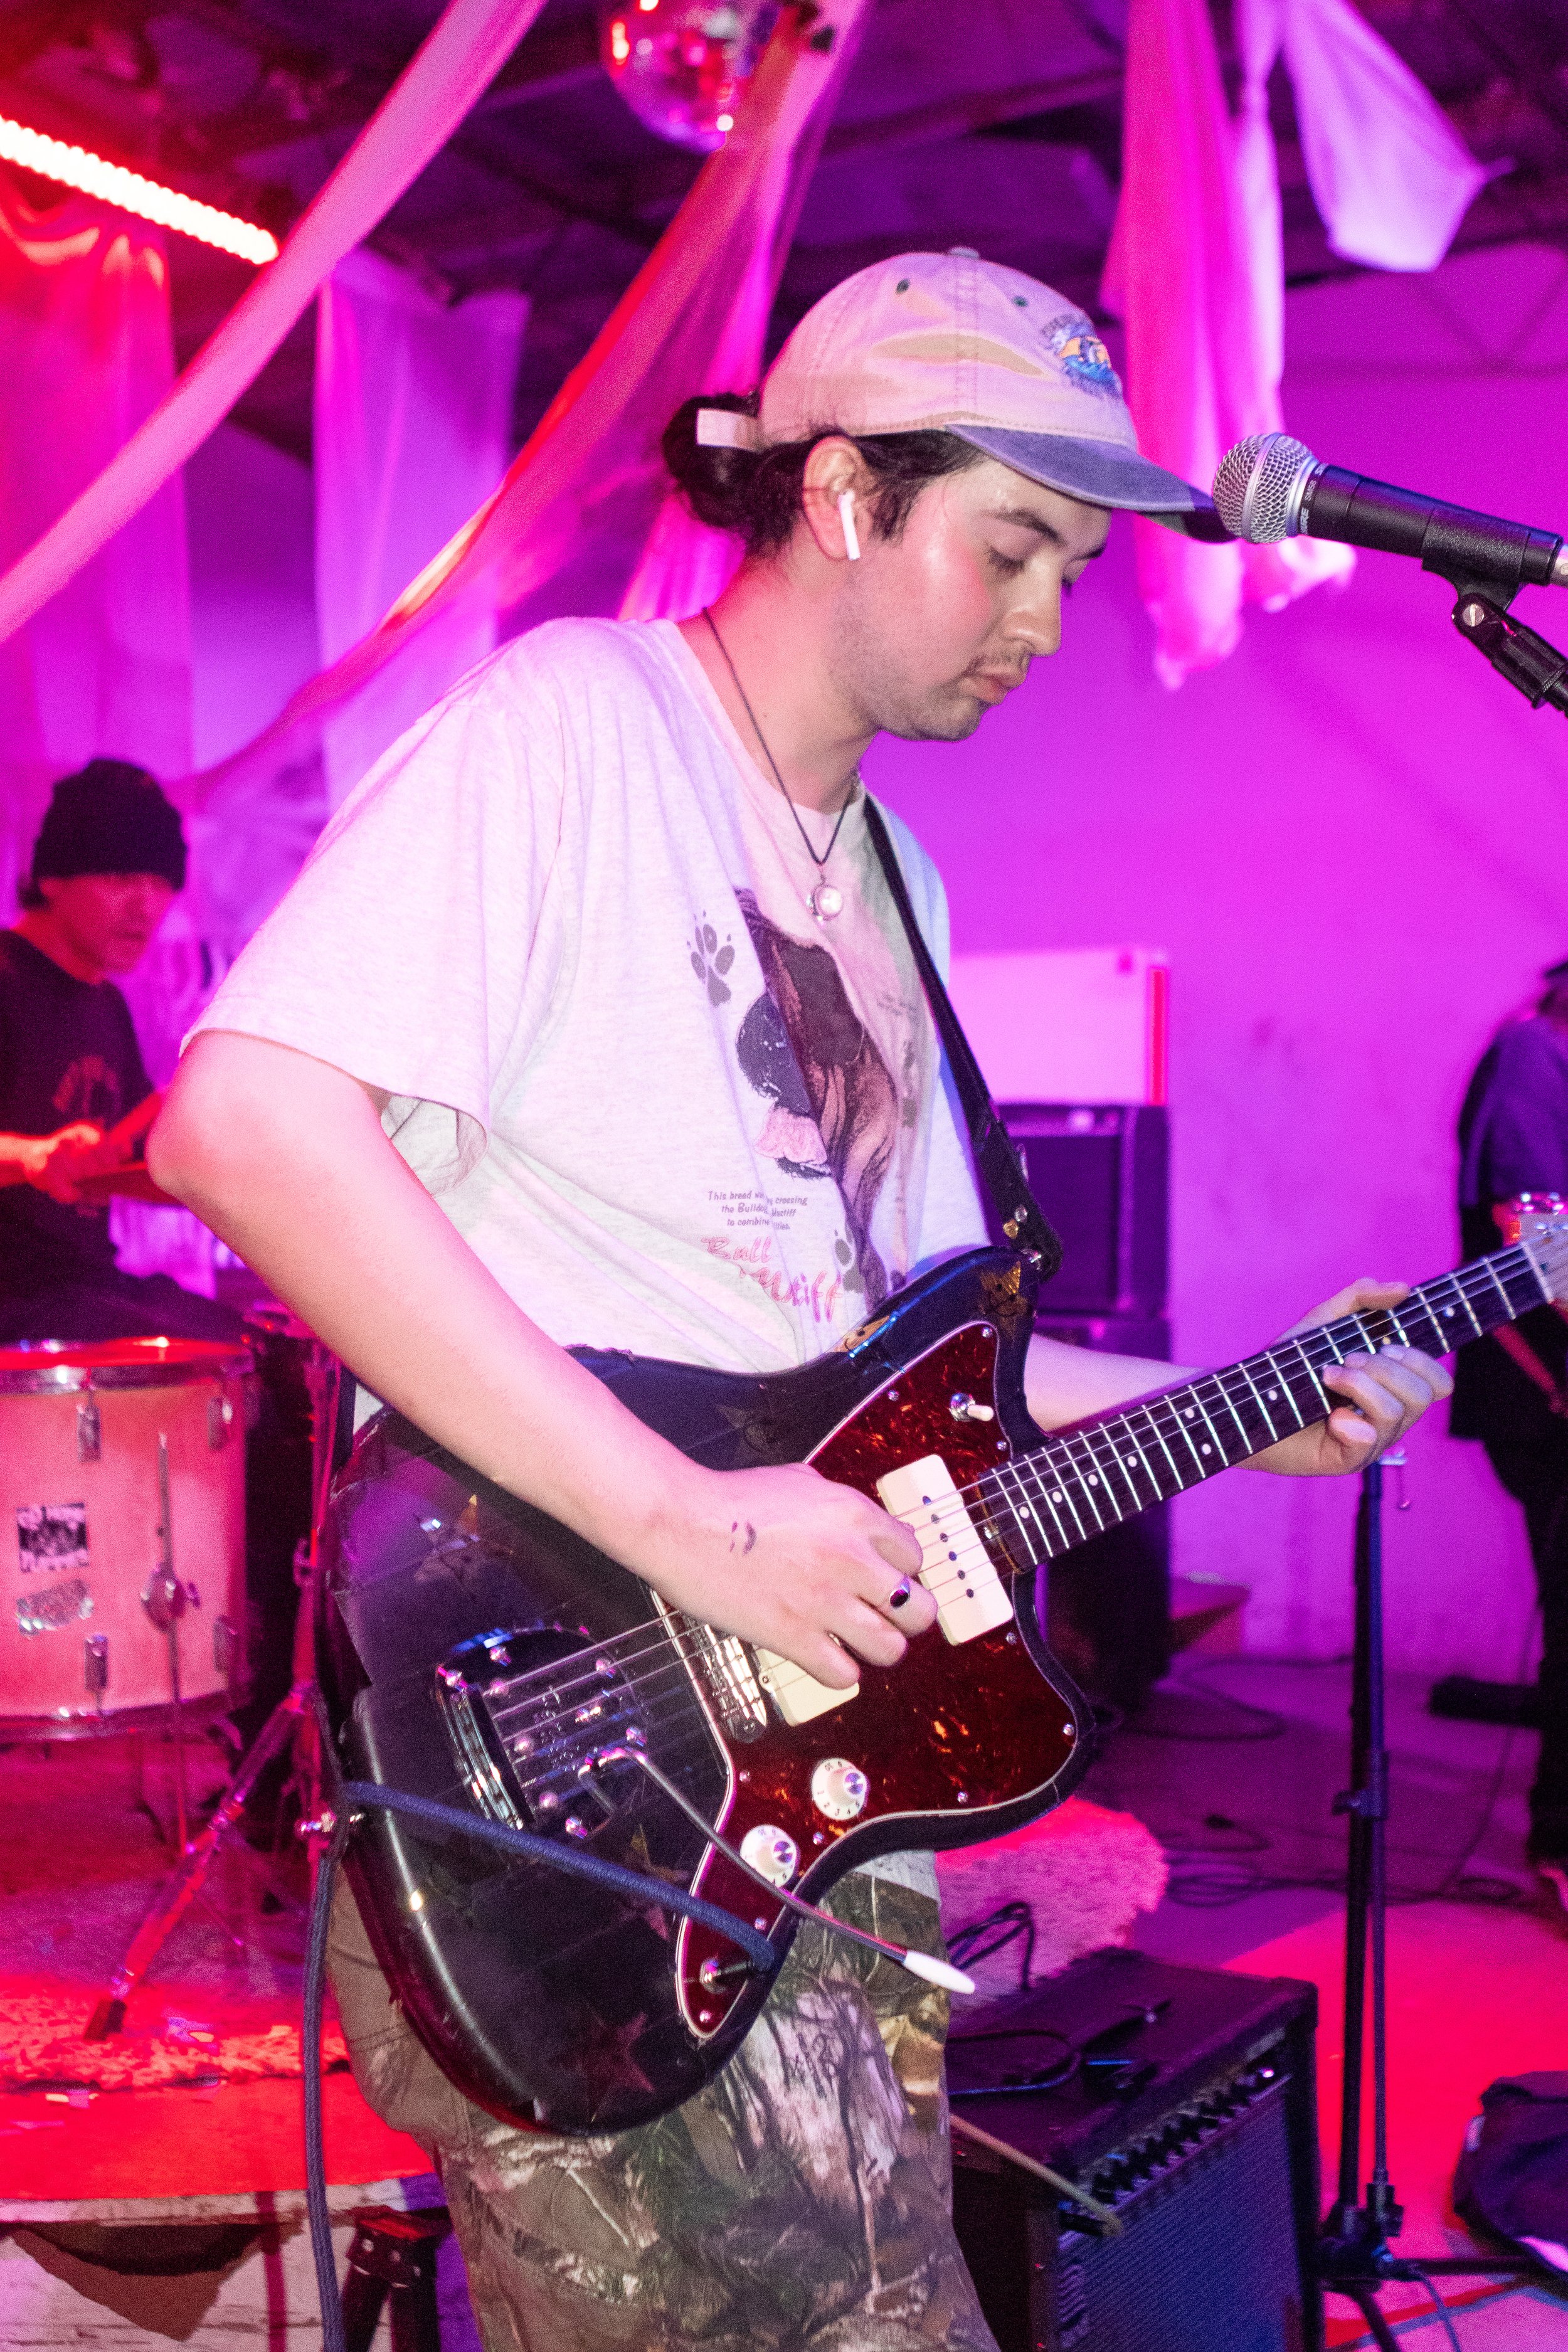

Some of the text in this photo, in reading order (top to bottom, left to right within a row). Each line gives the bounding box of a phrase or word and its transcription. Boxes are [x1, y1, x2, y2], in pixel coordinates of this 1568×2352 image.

[708, 1191, 726, 1200] This
[775, 1196, 808, 1206] crossing
[721, 1204, 734, 1213] the
[738, 1202, 769, 1214] Bulldog
[738, 1217, 770, 1226] combine
[701, 1236, 772, 1263] Bull
